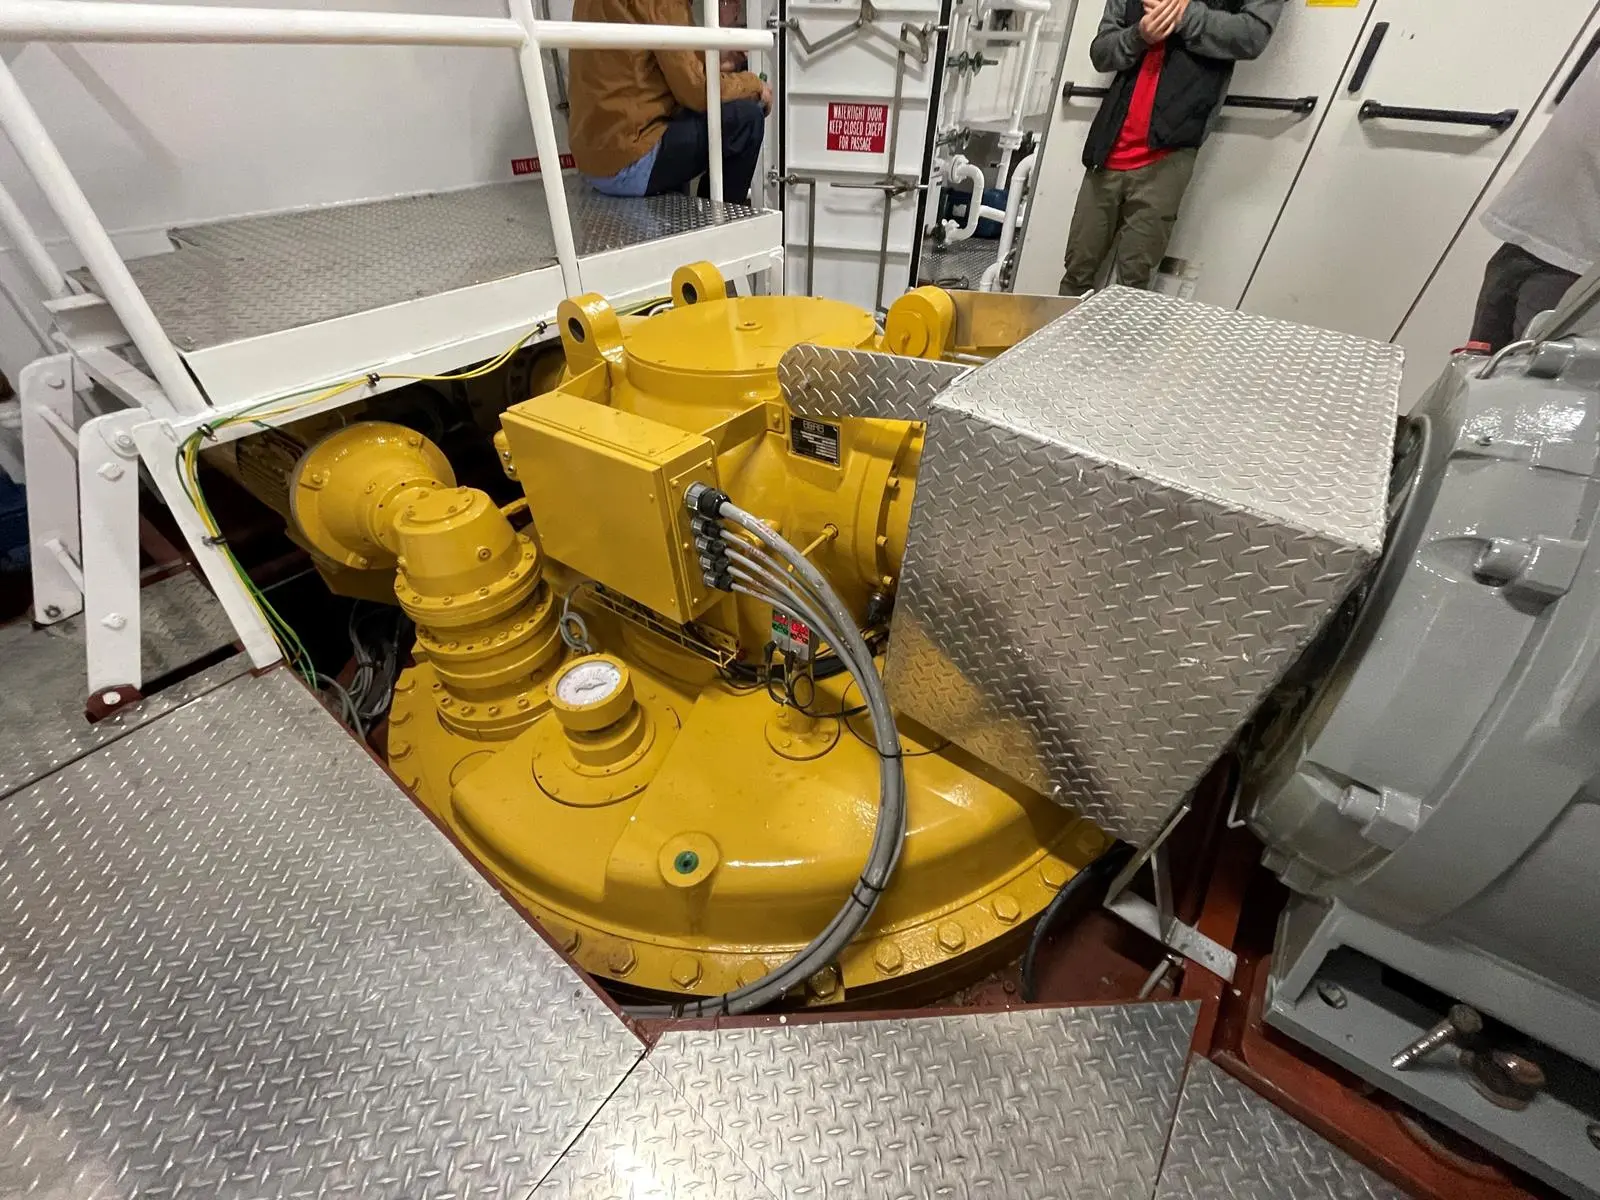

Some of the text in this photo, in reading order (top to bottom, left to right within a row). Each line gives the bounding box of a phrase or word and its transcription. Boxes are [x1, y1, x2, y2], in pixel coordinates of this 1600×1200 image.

[833, 105, 883, 121] WATERTIGHT DOOR
[829, 119, 885, 138] KEEP CLOSED EXCEPT
[838, 135, 872, 151] FOR PASSAGE
